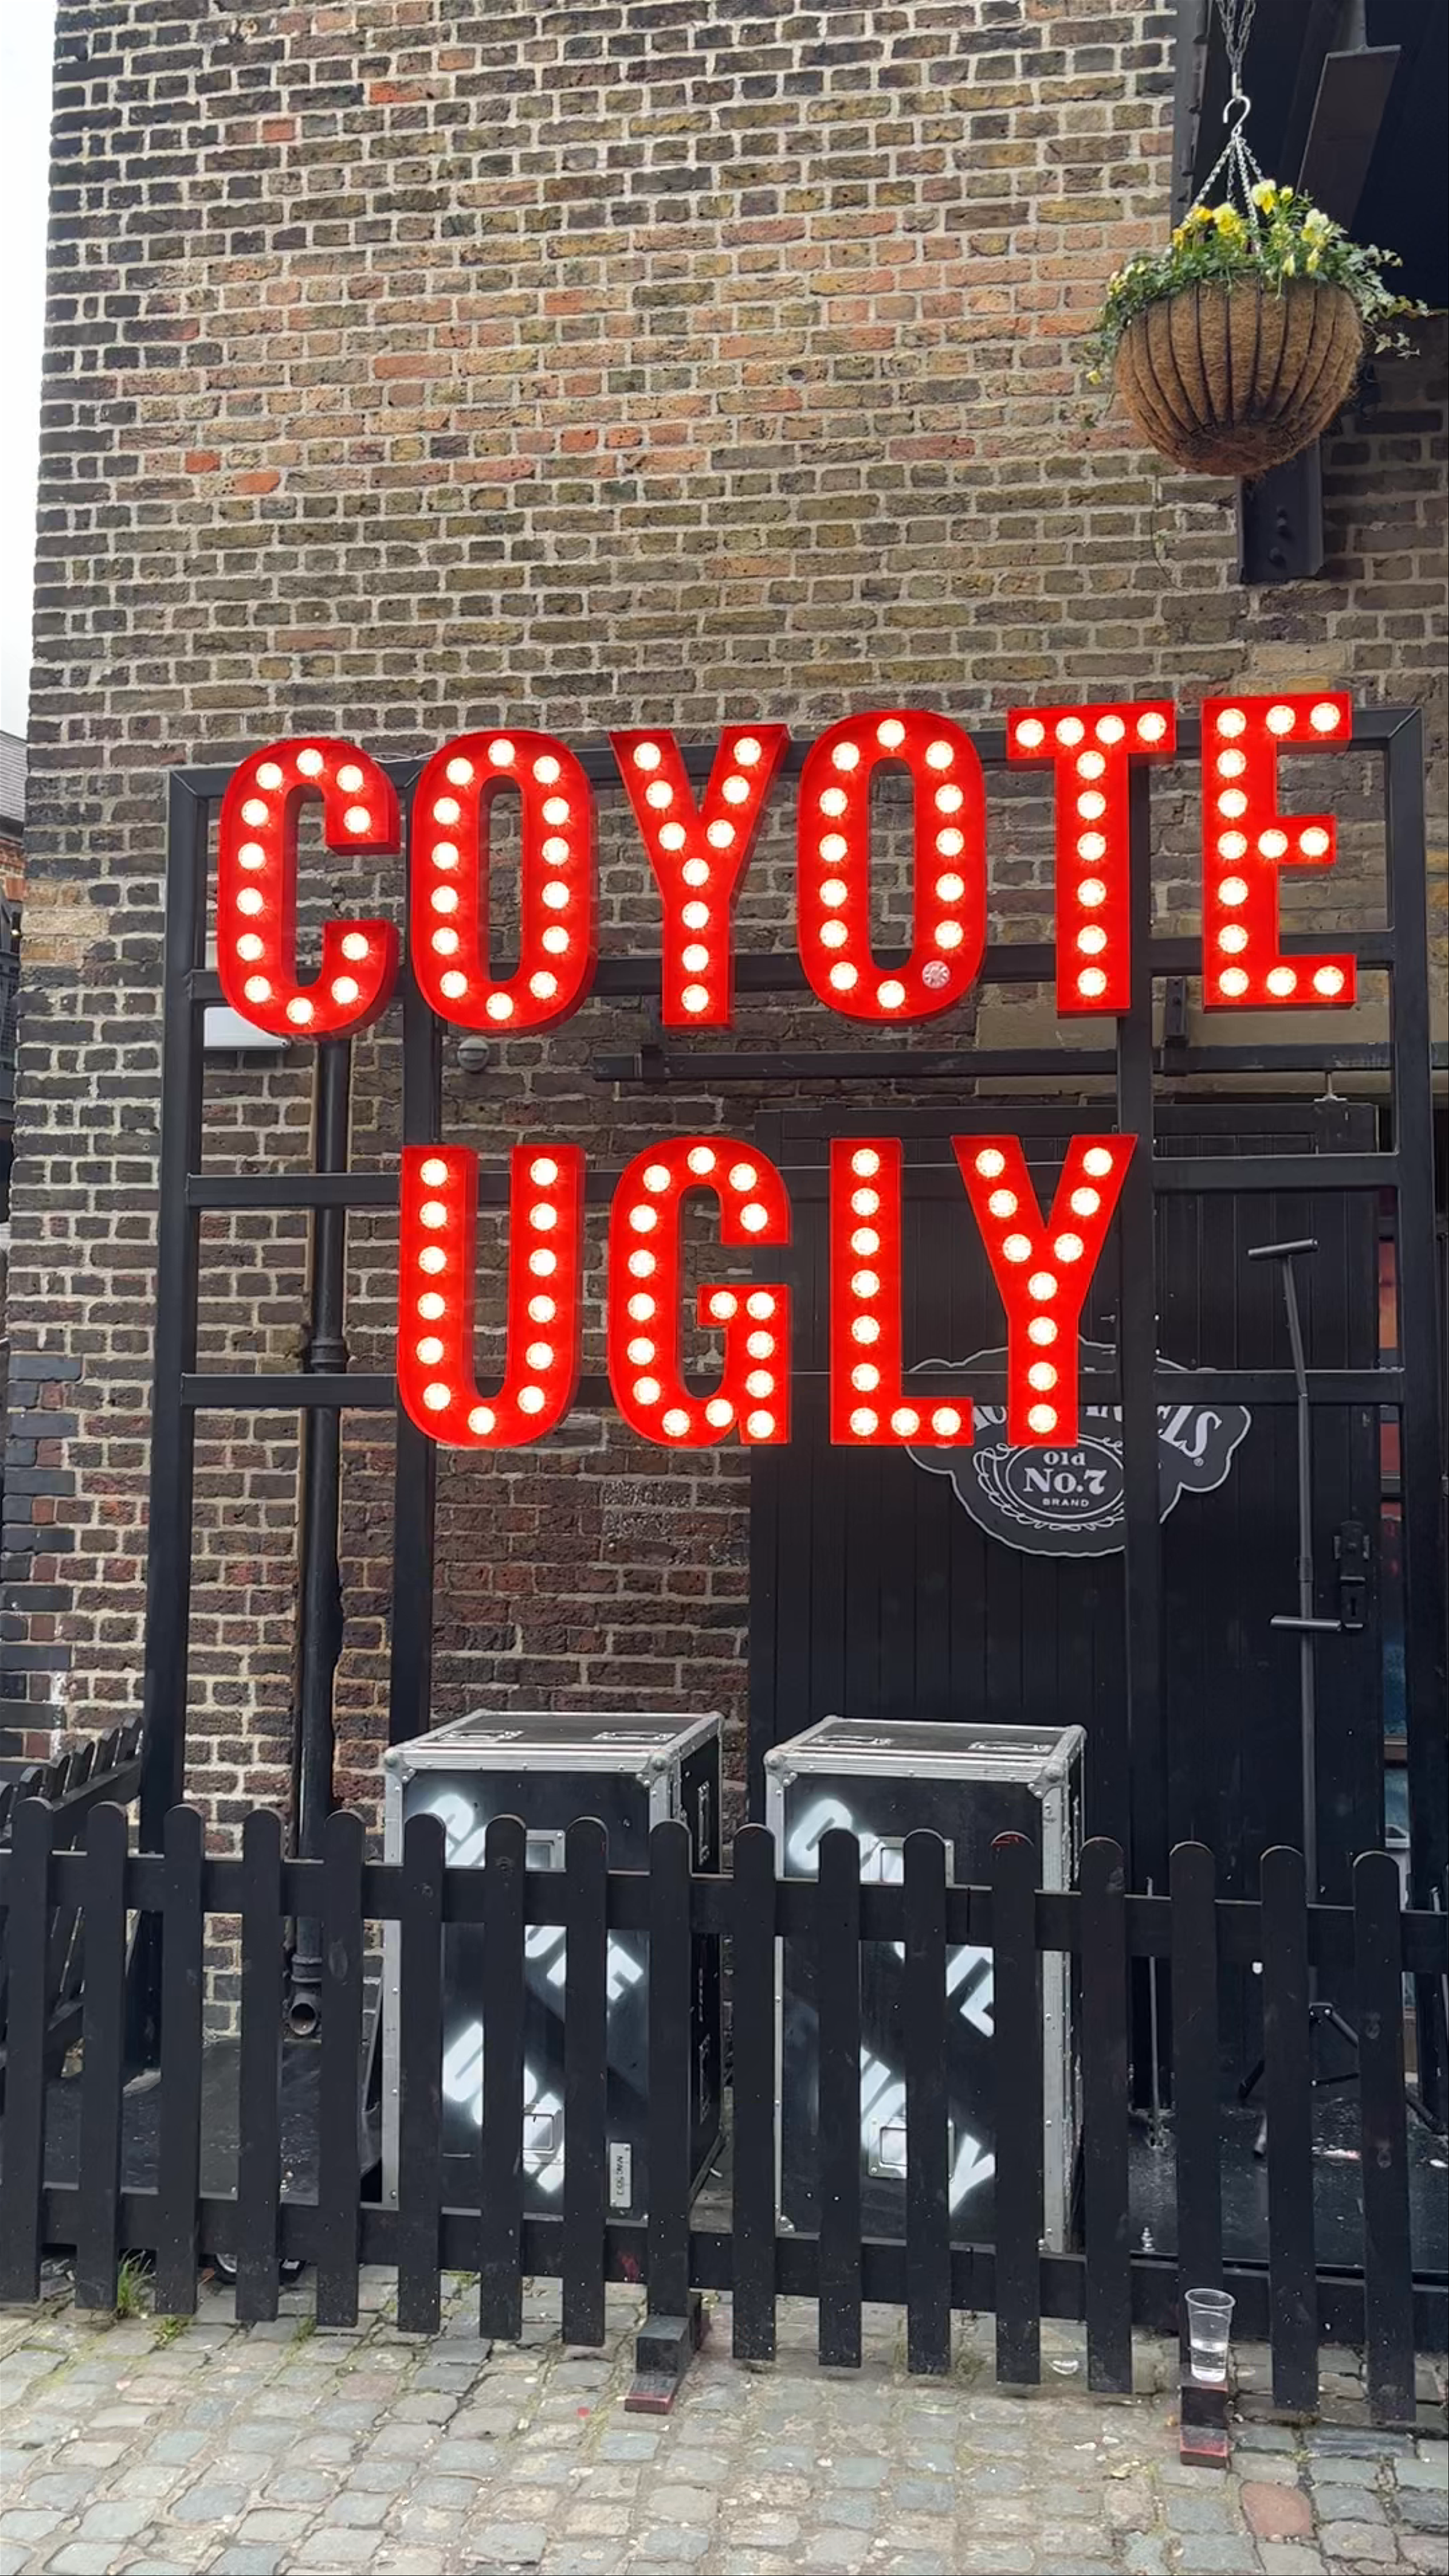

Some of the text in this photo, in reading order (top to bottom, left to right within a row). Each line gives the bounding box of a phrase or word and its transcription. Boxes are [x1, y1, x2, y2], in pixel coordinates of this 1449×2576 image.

[216, 693, 1356, 1036] COYOTE
[396, 1136, 1137, 1448] UGLY
[1043, 1451, 1086, 1466] Old
[1023, 1468, 1107, 1494] No.7
[1043, 1498, 1089, 1507] BRAND
